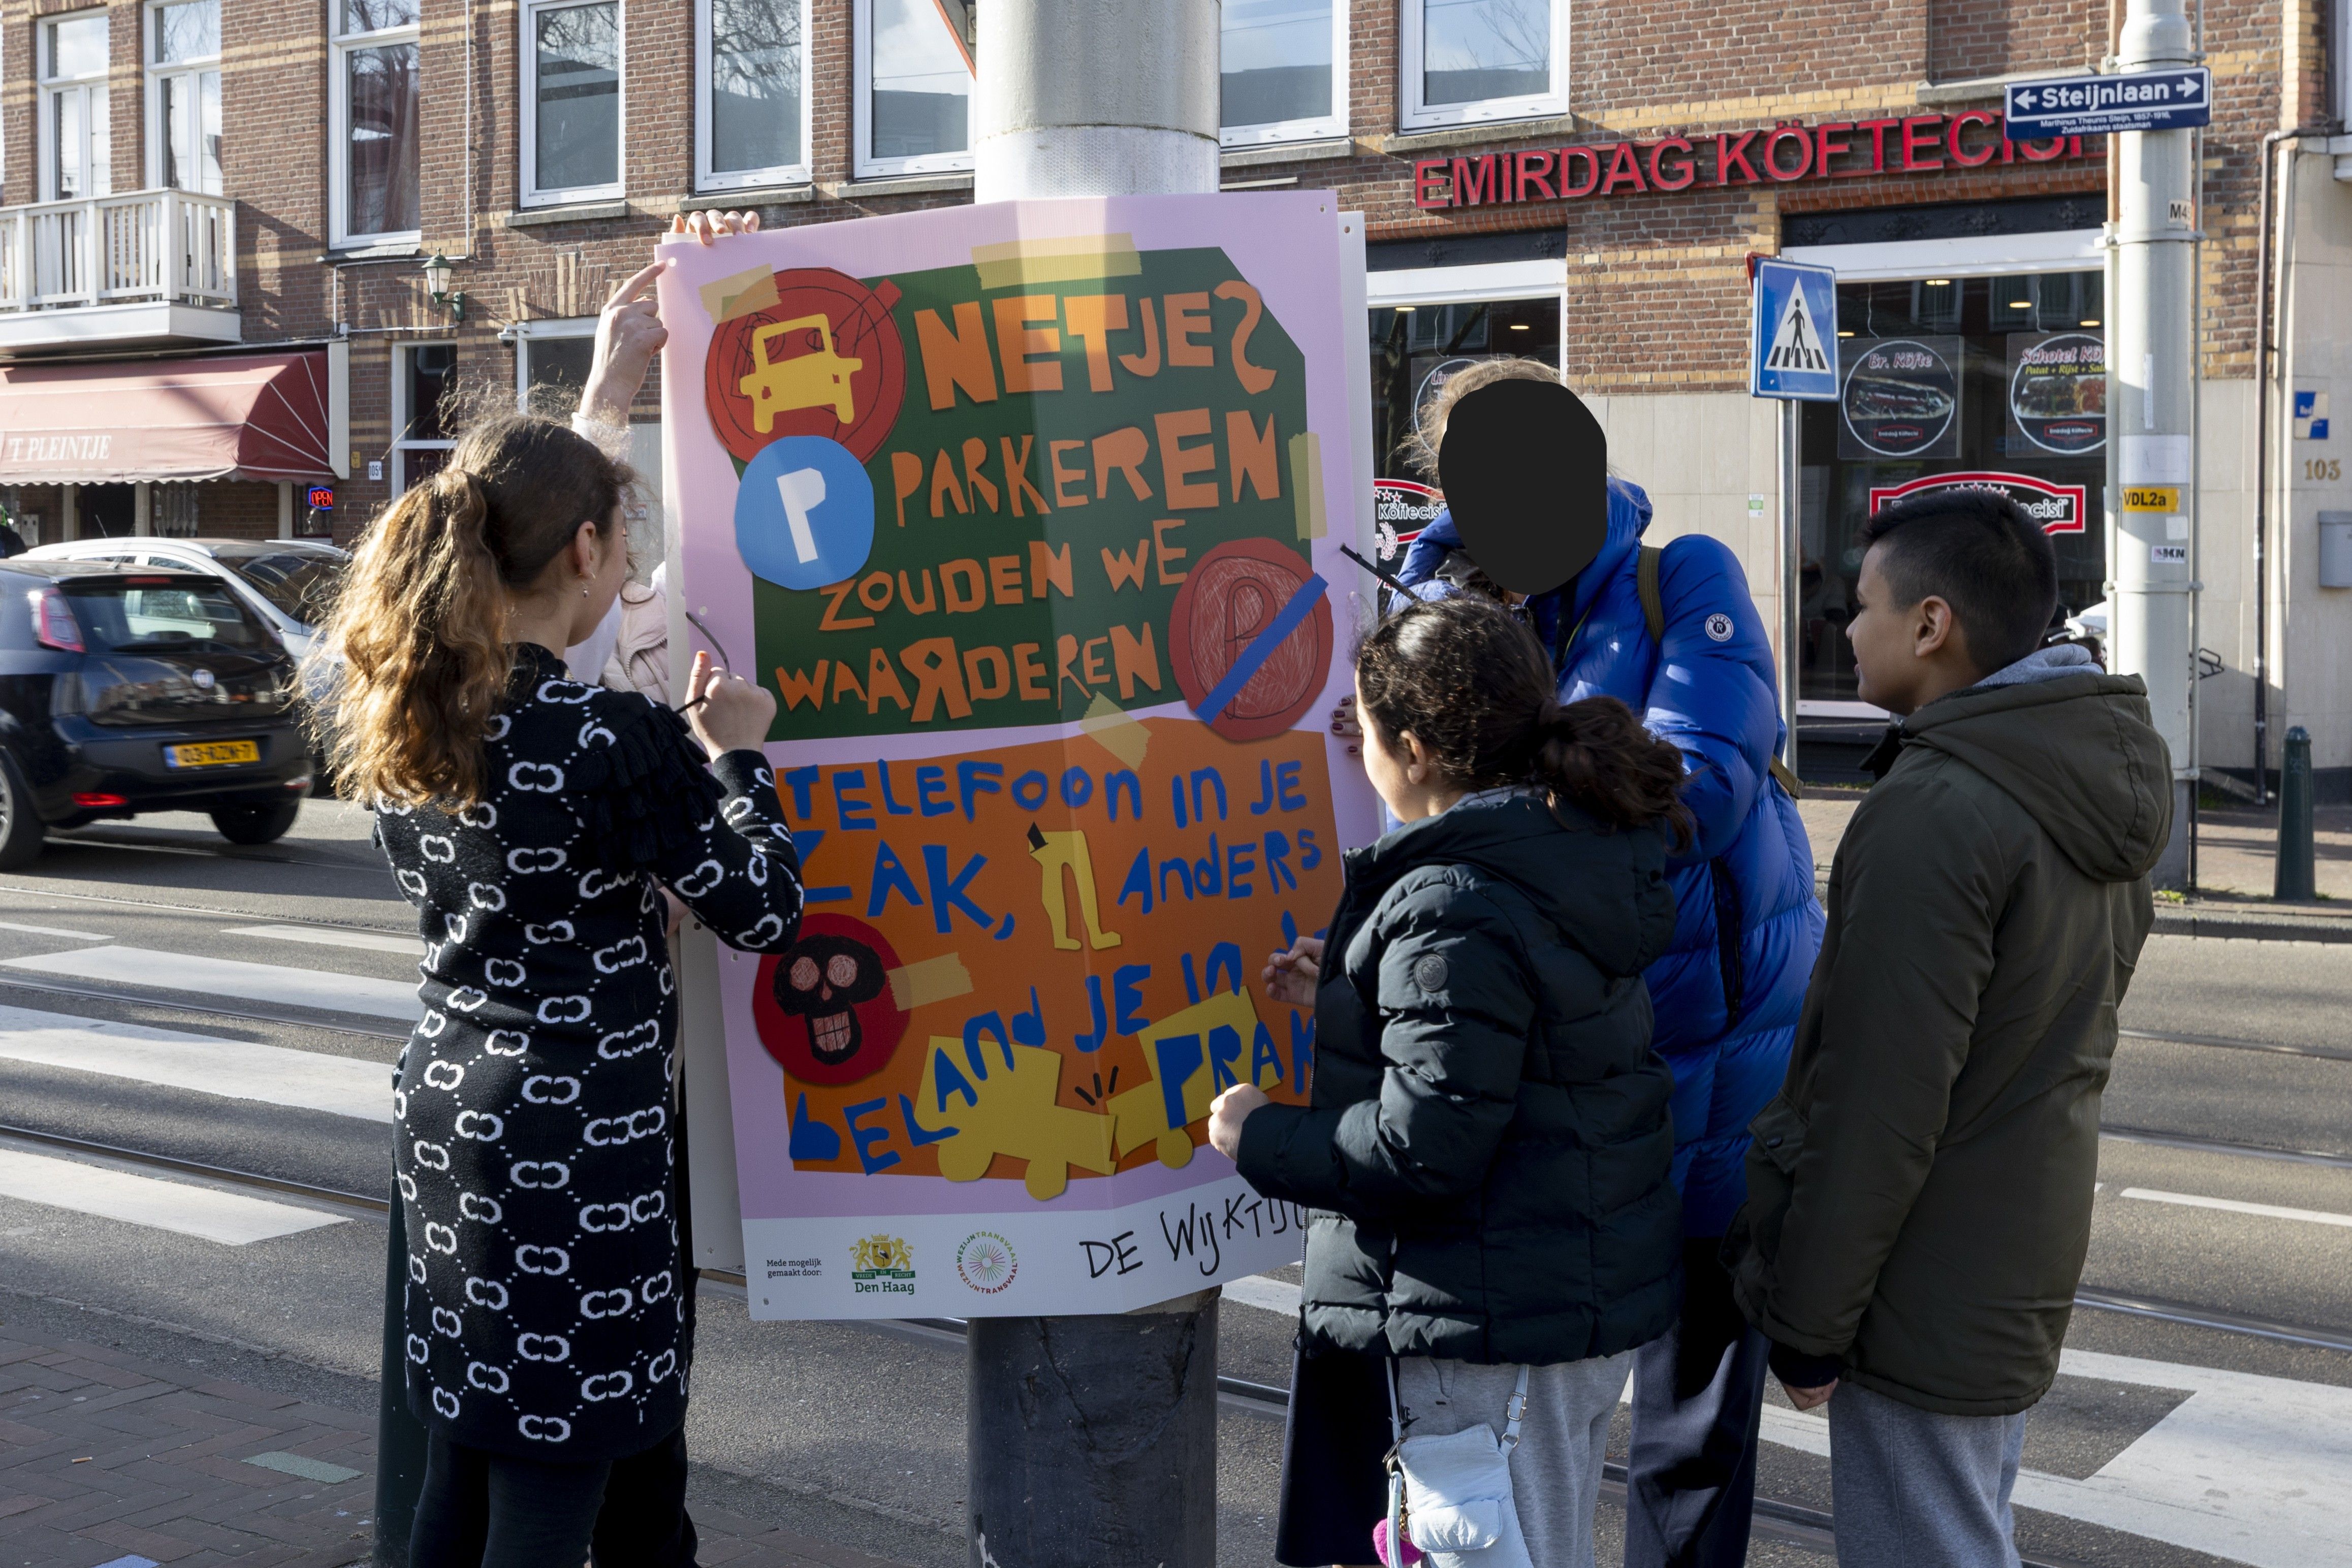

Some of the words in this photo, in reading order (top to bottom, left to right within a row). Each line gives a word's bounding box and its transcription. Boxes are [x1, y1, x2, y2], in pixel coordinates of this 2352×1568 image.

[2041, 81, 2170, 111] Steijnlaan
[2040, 119, 2077, 128] Marthinus
[2078, 116, 2107, 125] Theunis
[2108, 113, 2132, 123] Steijn,
[2061, 124, 2111, 134] Zuidafrikaans
[2112, 121, 2152, 131] staatsman
[913, 280, 1277, 410] NETJES
[2020, 346, 2078, 365] Schotel
[1893, 351, 1933, 370] Köfte
[2025, 365, 2049, 375] Patat
[2058, 364, 2079, 375] Rijst
[2088, 363, 2105, 373] Sal
[25, 435, 112, 461] PLEINTJE
[891, 408, 1280, 527] PARKEREN
[311, 491, 333, 506] OPEN
[2124, 492, 2167, 506] VDL2a
[818, 540, 1073, 631] ZOUDEN
[1100, 519, 1190, 590] WE
[775, 622, 1162, 723] WAARDEREN
[1249, 759, 1308, 816] JE
[1074, 963, 1152, 1053] JE
[1154, 1008, 1315, 1131] PRAK
[788, 1258, 822, 1268] mogelijk
[1079, 1231, 1143, 1278] DE
[767, 1269, 801, 1278] gemaakt
[854, 1282, 879, 1293] Den
[882, 1282, 915, 1295] Haag
